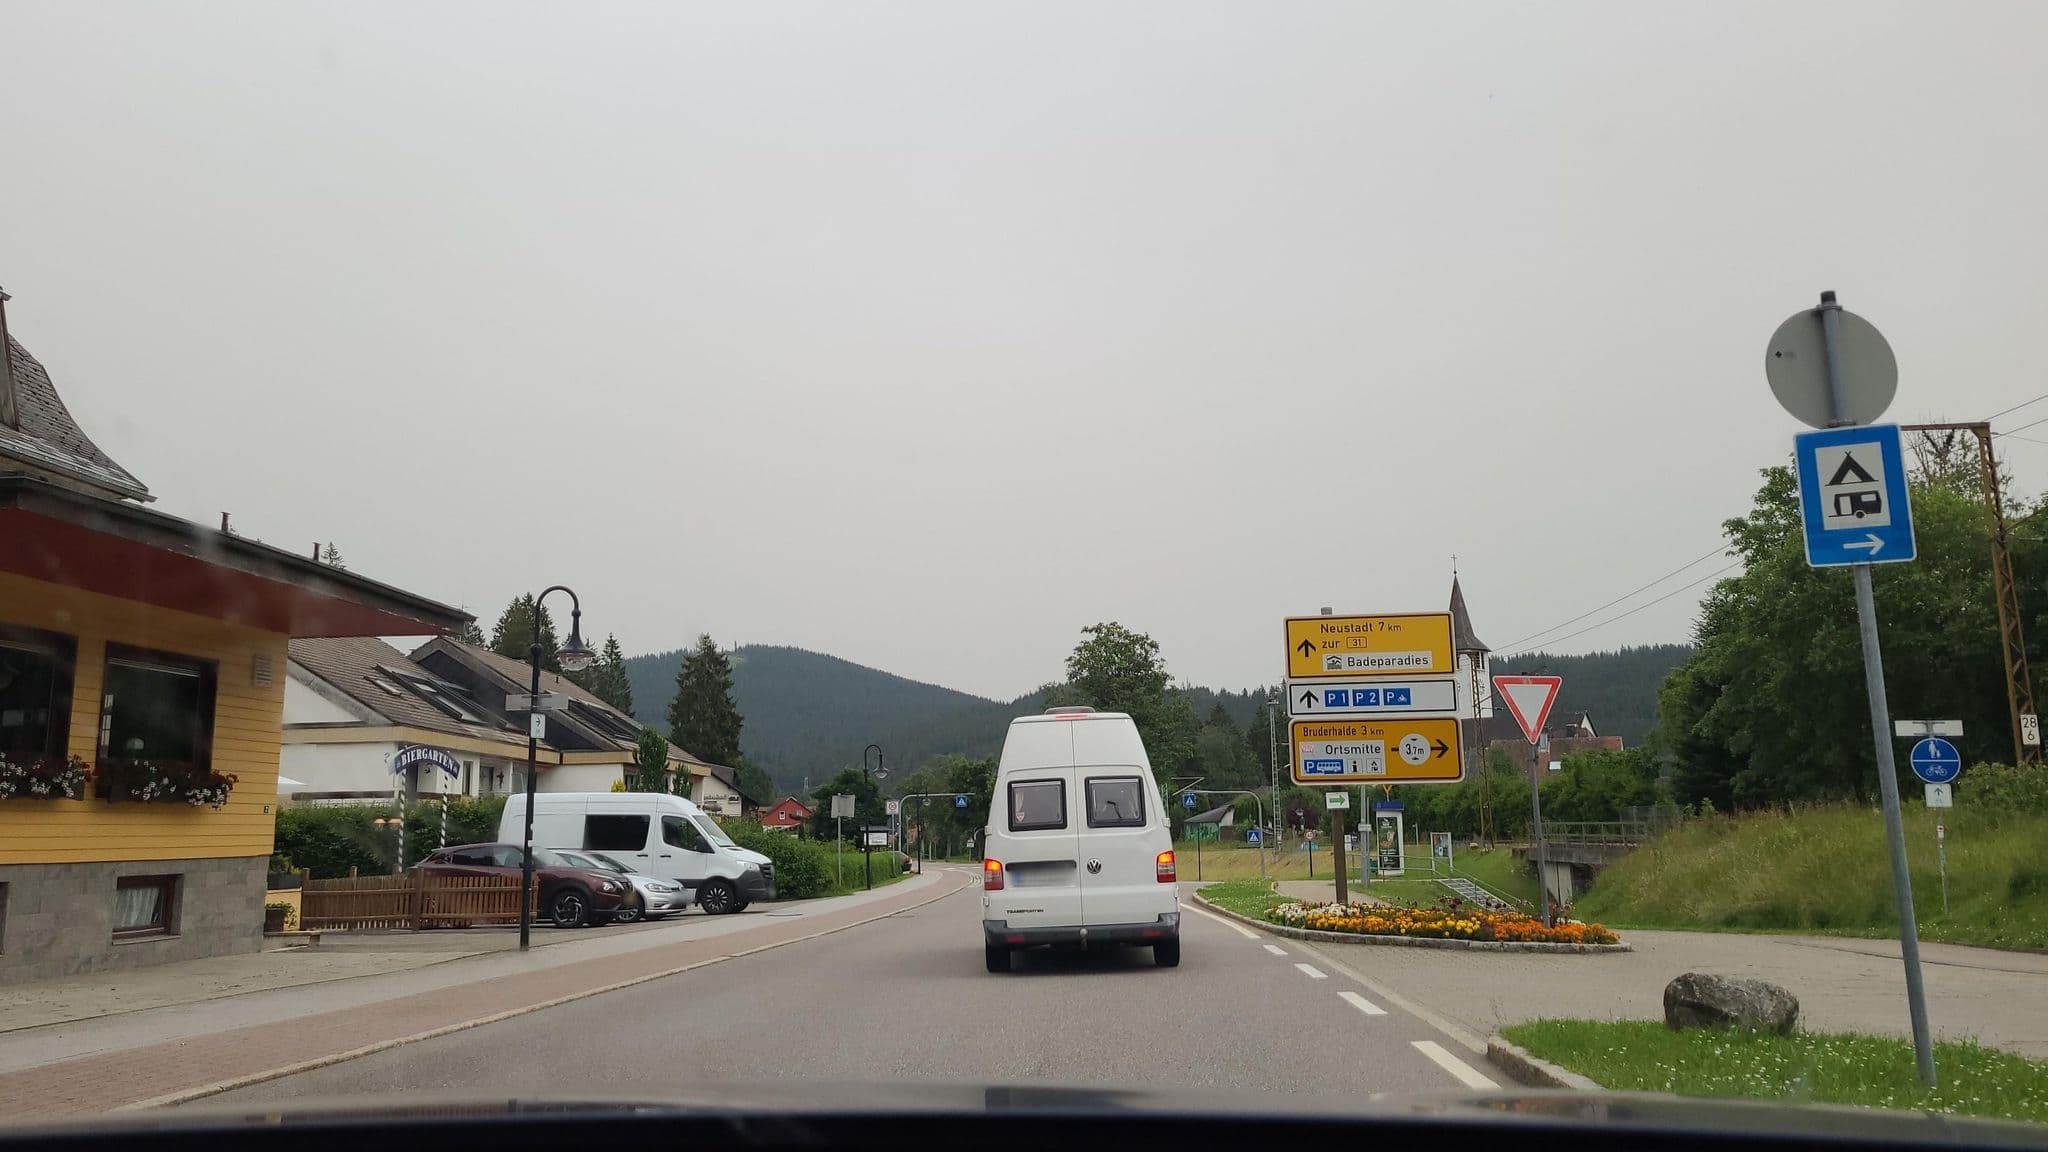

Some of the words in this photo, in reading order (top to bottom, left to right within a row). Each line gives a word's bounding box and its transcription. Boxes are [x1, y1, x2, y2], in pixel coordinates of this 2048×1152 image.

[1320, 622, 1373, 633] Neustadt
[1378, 621, 1385, 632] 7
[1388, 623, 1402, 632] km
[1322, 639, 1341, 649] zur
[1352, 638, 1362, 647] 31
[1347, 654, 1429, 669] Badeparadies
[1386, 691, 1395, 703] P
[2022, 717, 2037, 729] 28
[1303, 726, 1357, 737] Bruderhalde
[1361, 725, 1368, 736] 3
[1370, 727, 1384, 735] km
[2027, 730, 2035, 741] 6
[1325, 743, 1381, 755] Ortsmitte
[401, 748, 455, 772] BIERGARTEN
[1306, 761, 1315, 773] P
